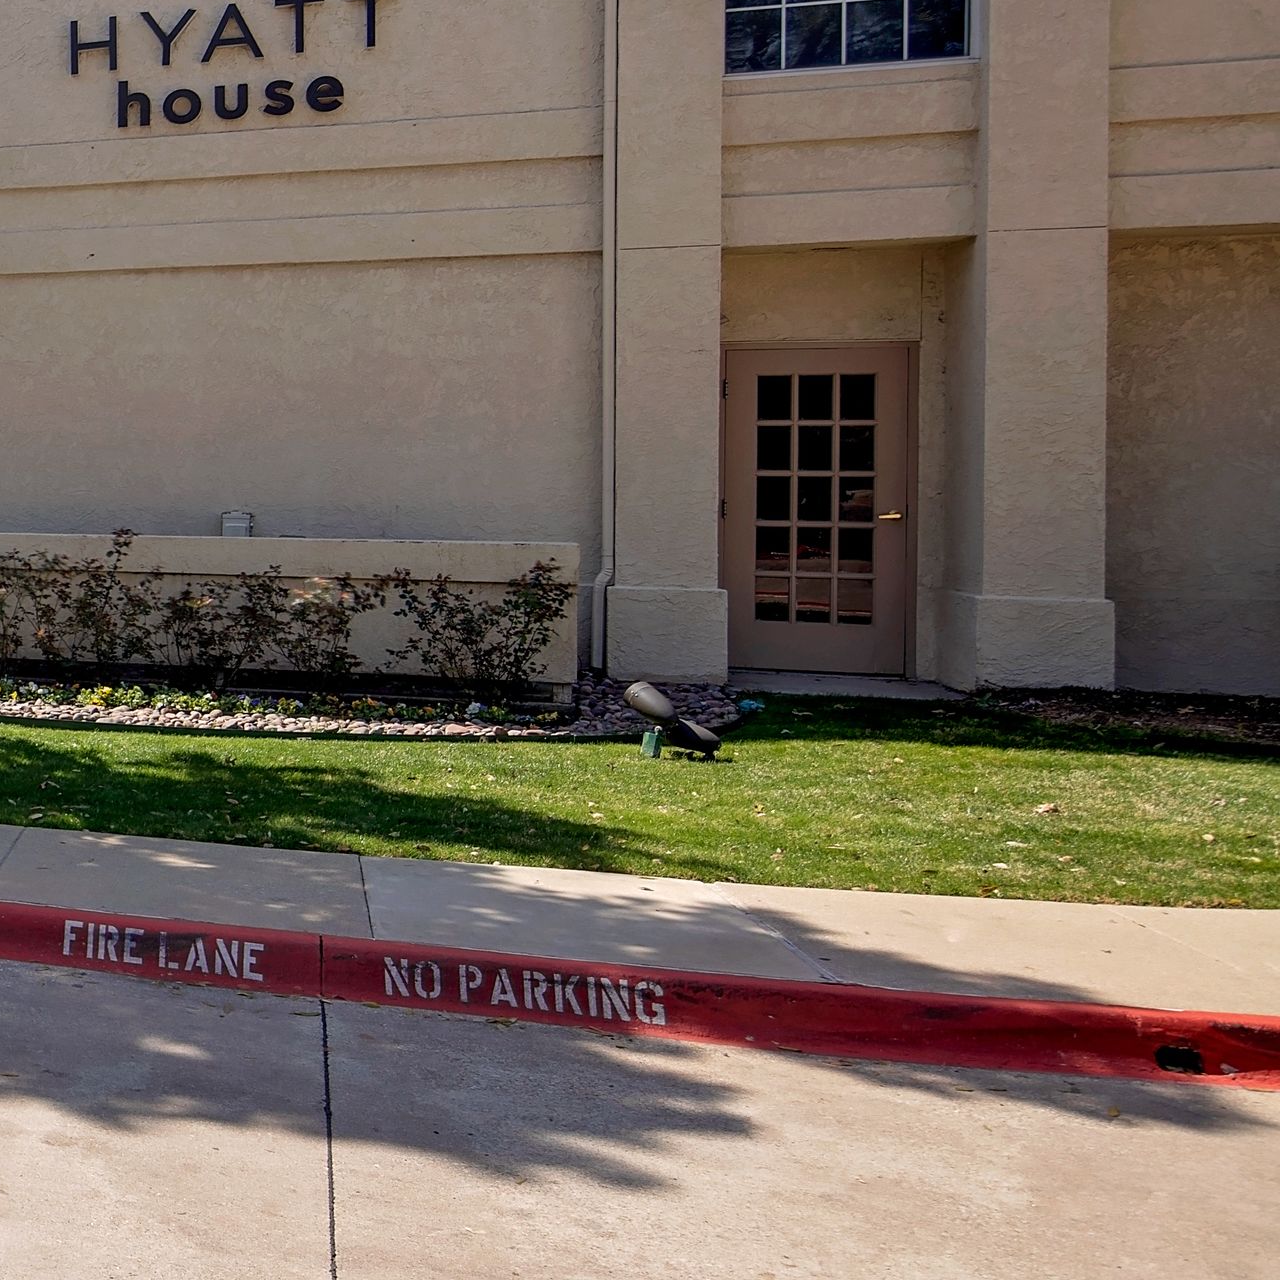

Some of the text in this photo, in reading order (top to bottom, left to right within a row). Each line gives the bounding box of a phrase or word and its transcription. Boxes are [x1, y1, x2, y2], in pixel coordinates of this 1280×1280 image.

[117, 75, 345, 128] house
[62, 920, 666, 1026] FIRE LANE NO PARKING
